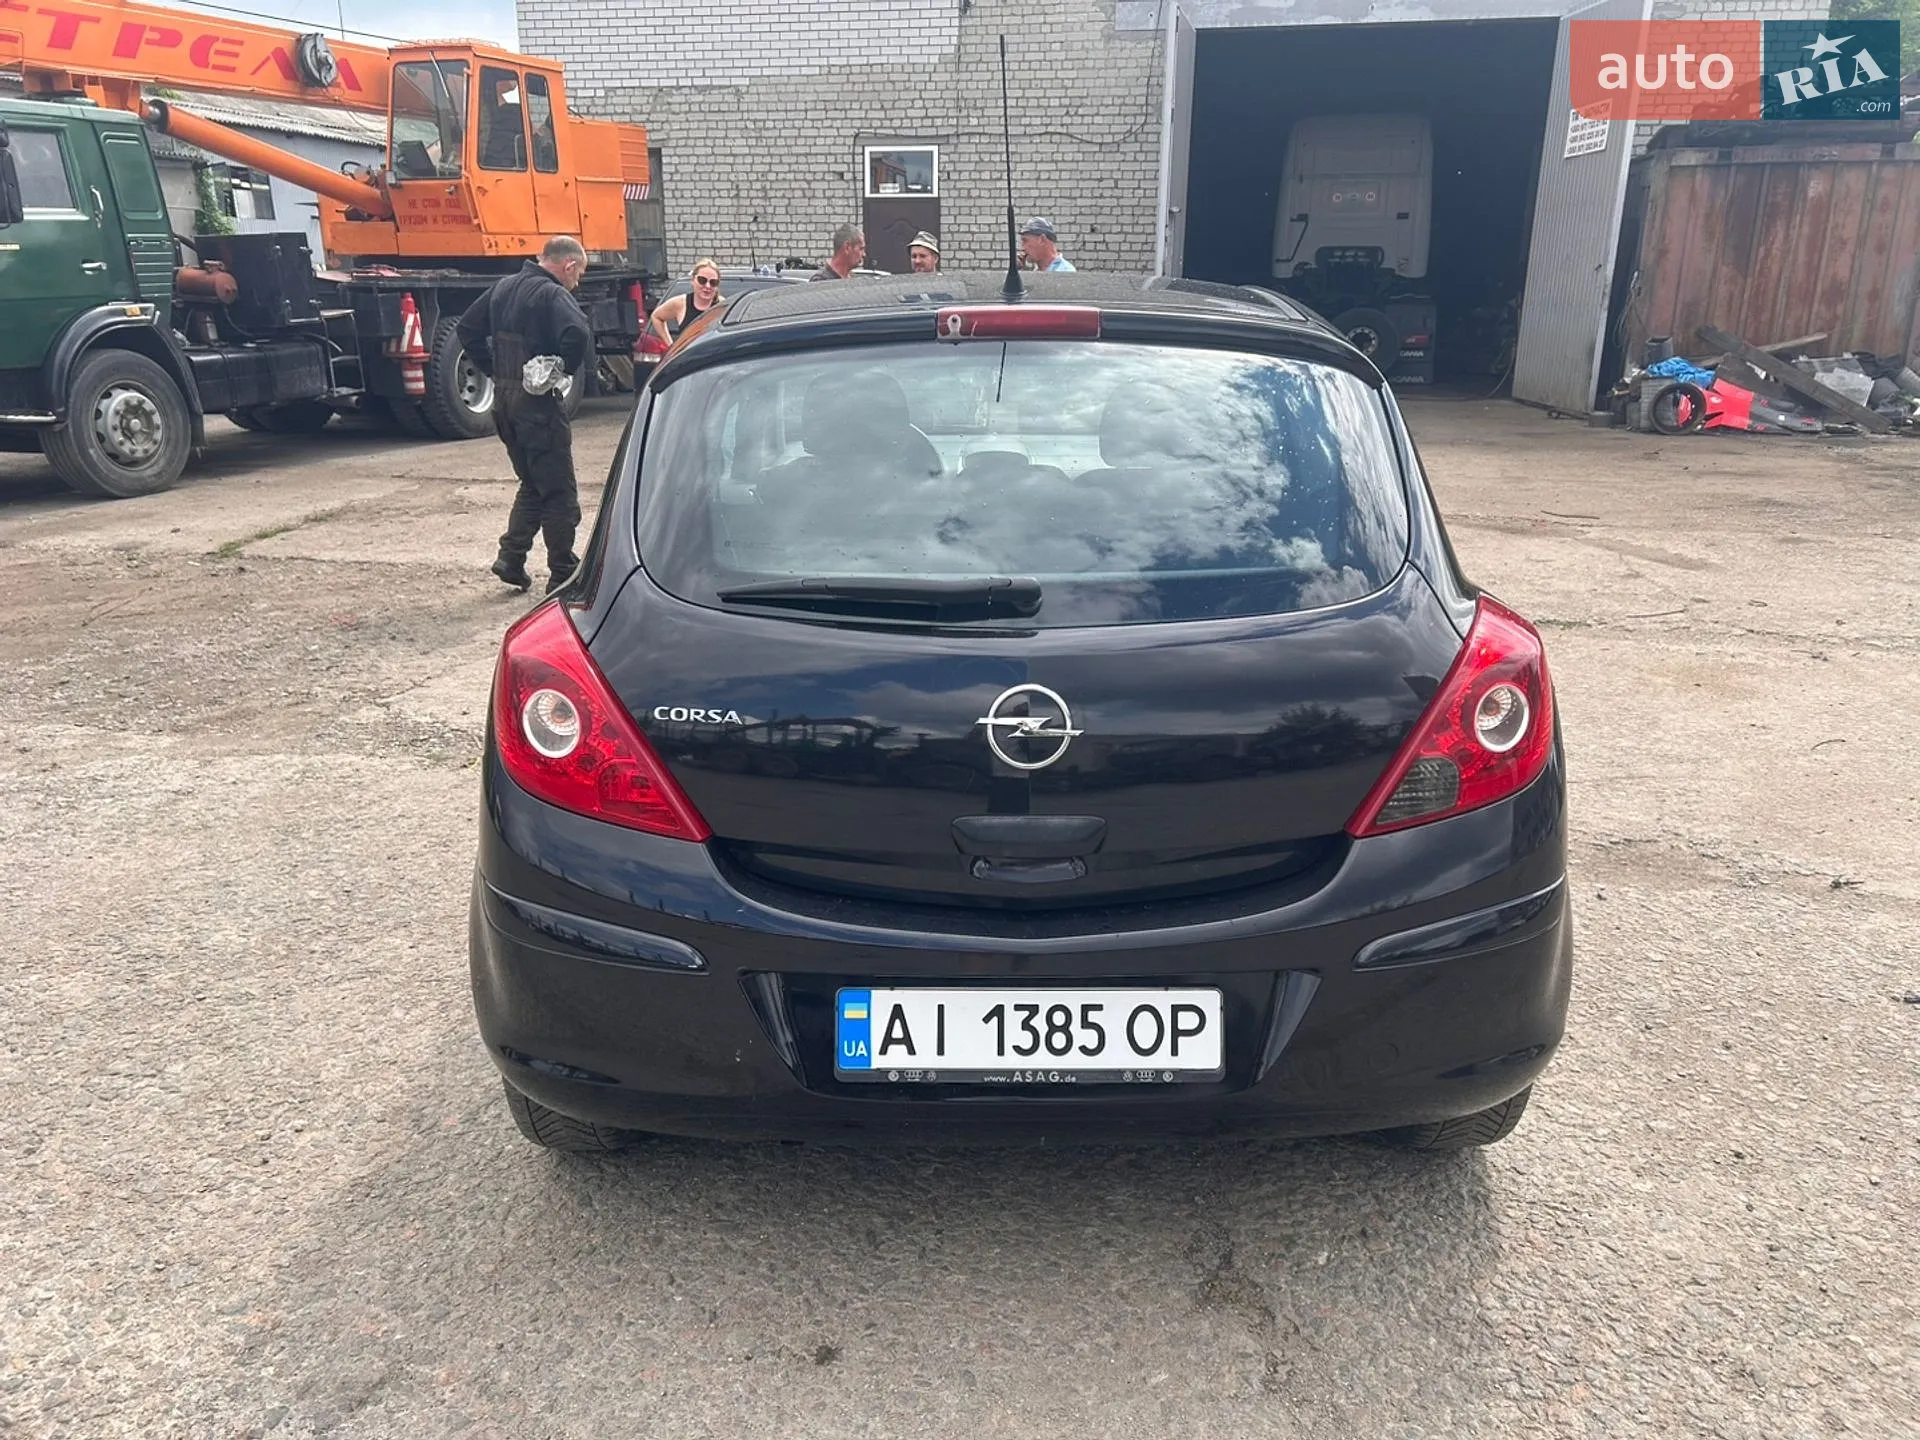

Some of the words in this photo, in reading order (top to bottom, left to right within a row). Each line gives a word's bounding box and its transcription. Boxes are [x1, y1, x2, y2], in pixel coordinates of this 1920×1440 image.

[653, 706, 743, 725] CORSA
[982, 1003, 1106, 1057] 1385
[1126, 1003, 1207, 1057] OP
[844, 1040, 868, 1057] UA
